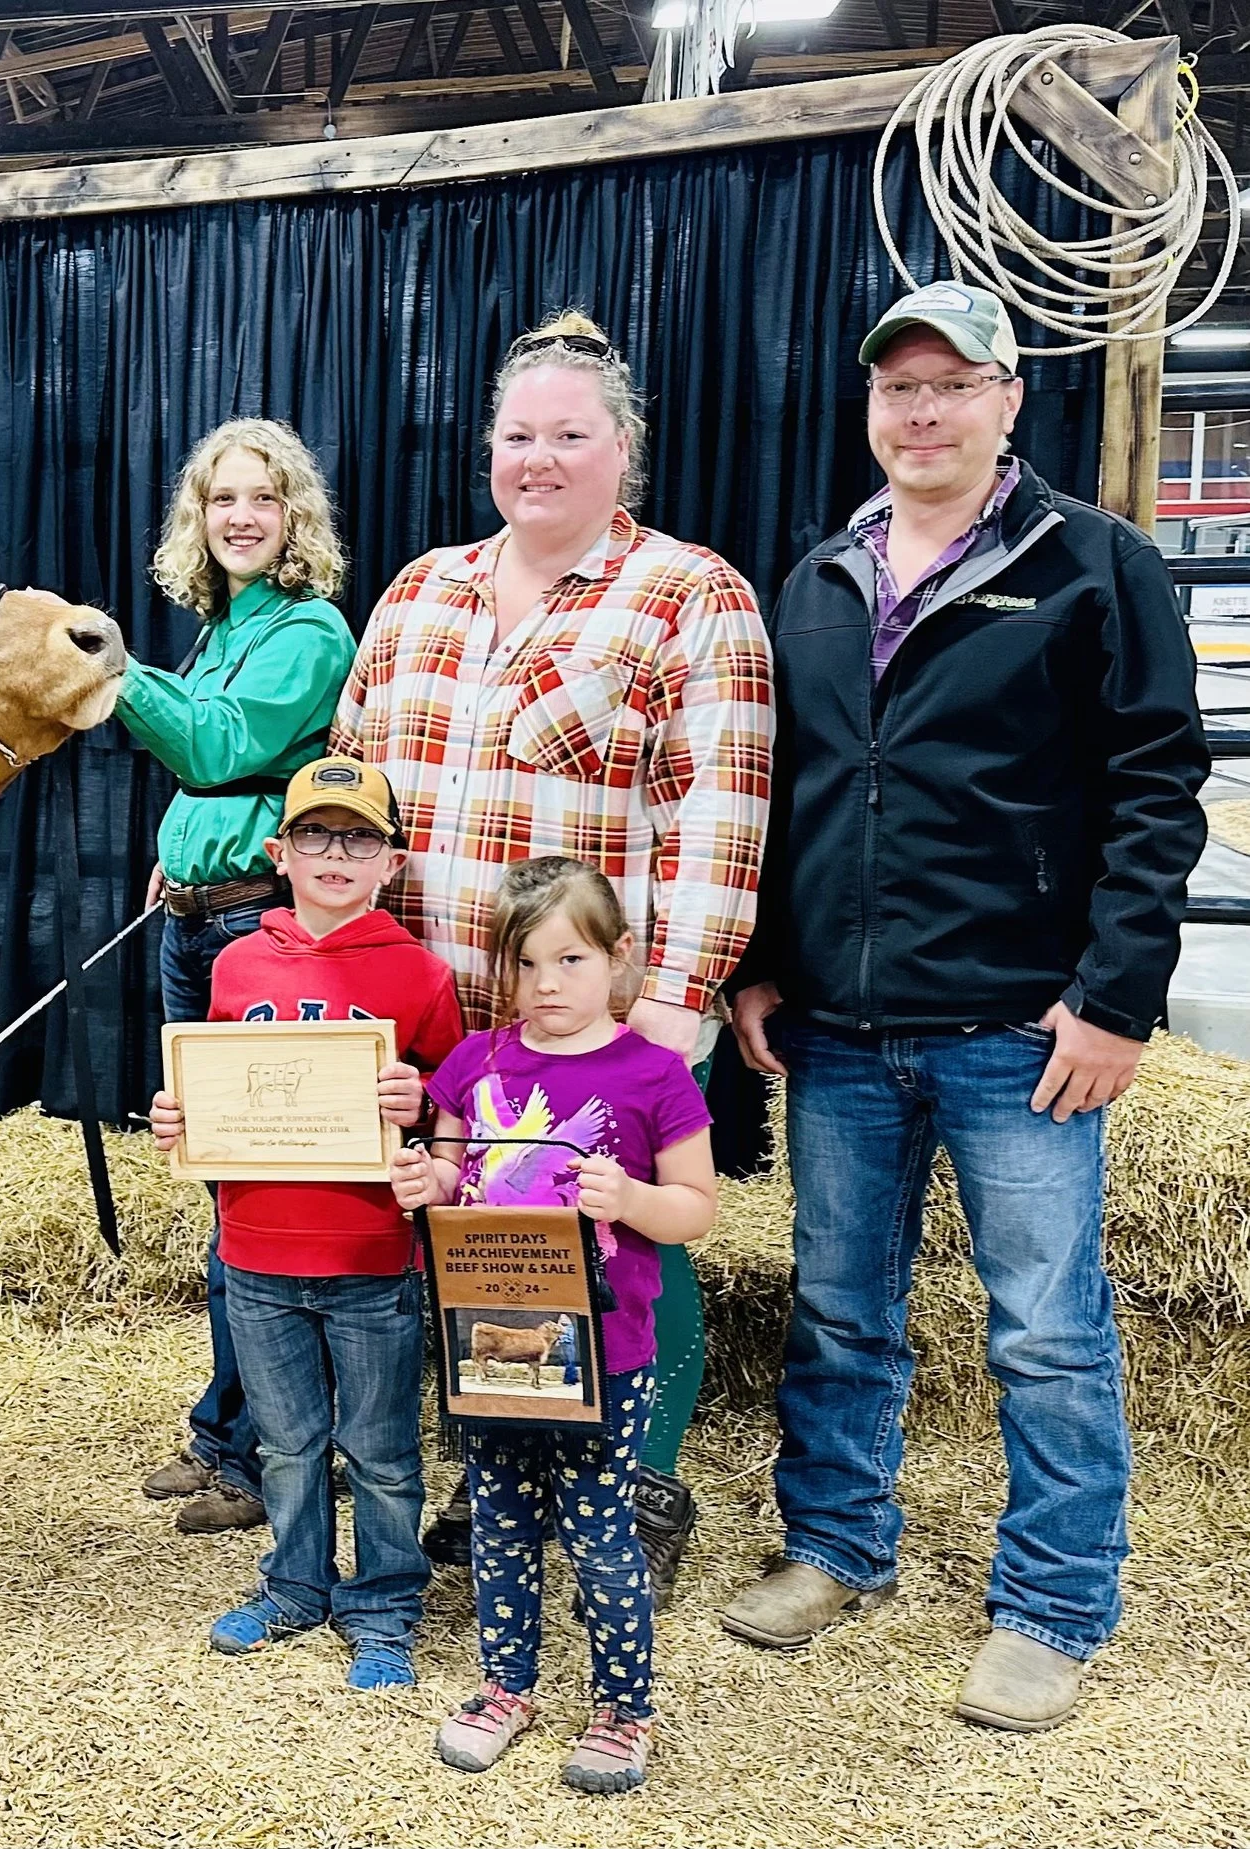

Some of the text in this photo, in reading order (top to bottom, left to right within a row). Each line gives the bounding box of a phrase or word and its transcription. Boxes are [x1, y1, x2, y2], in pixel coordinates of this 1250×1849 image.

[1213, 596, 1248, 606] KINETTE
[222, 1115, 249, 1123] THANK
[464, 1233, 547, 1244] SPIRIT DAYS
[446, 1248, 570, 1259] 4H ACHIEVEMENT
[445, 1262, 577, 1274] BEEF SHOW & SALE
[485, 1284, 540, 1294] 20 24
